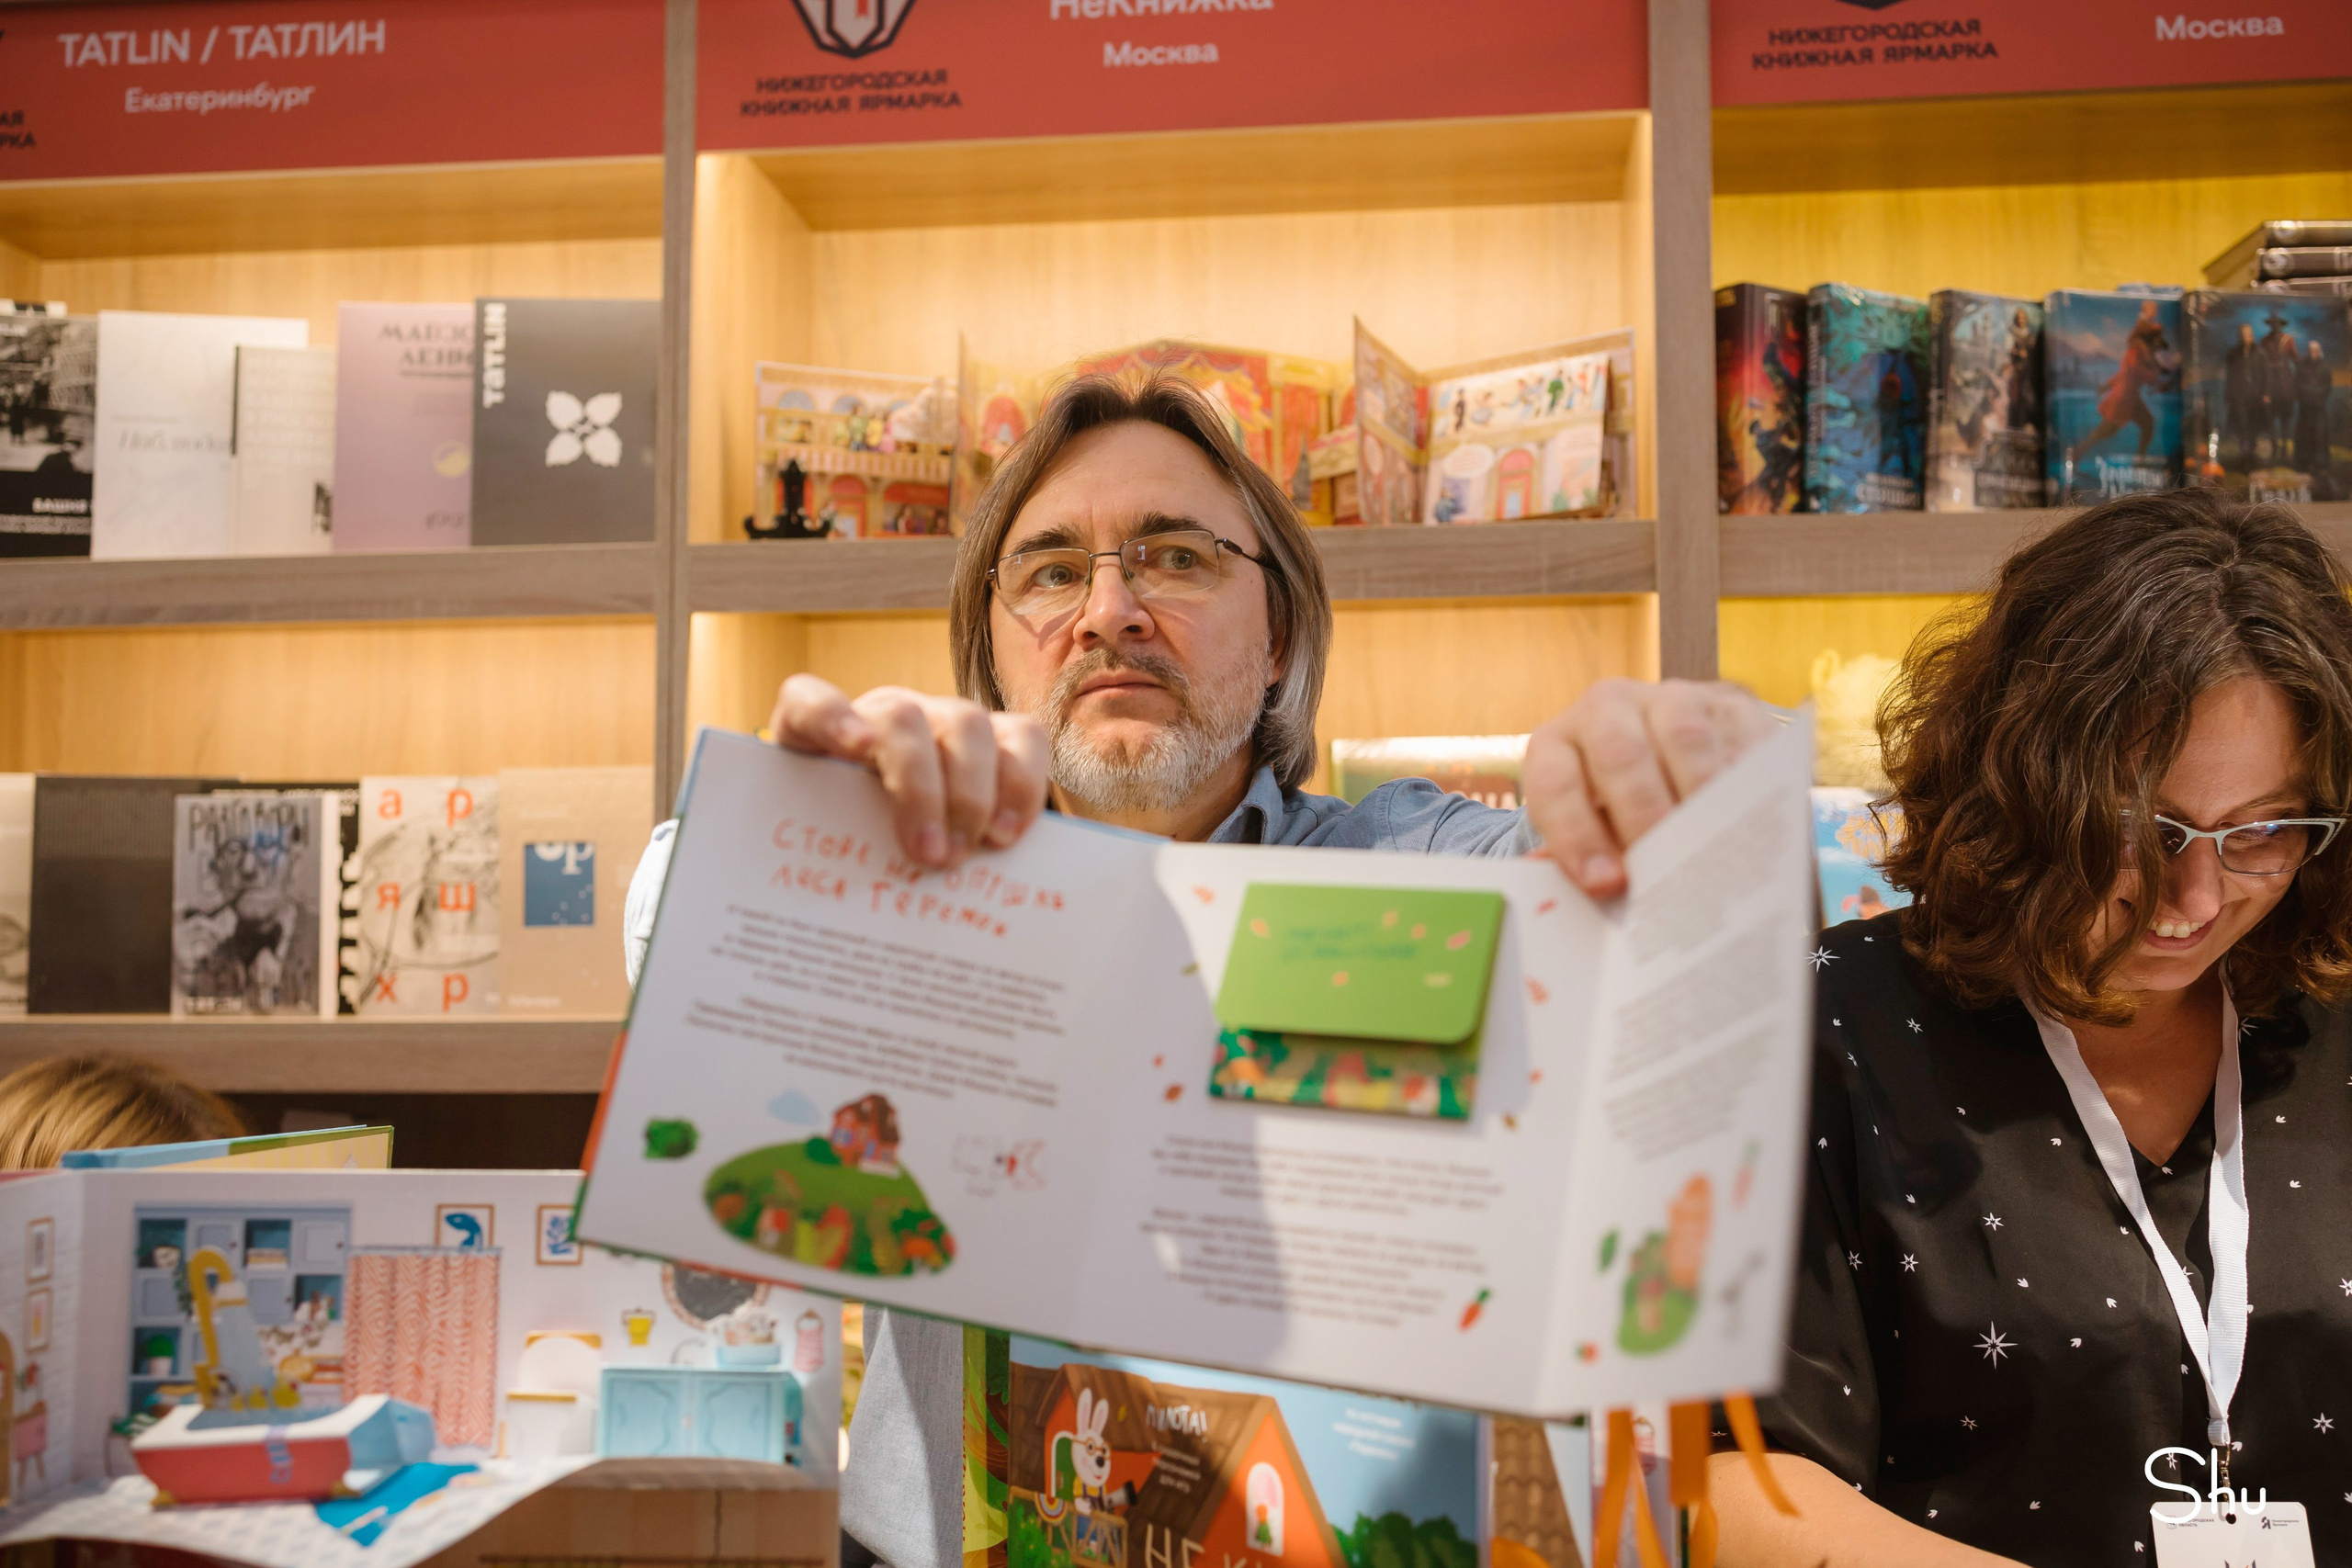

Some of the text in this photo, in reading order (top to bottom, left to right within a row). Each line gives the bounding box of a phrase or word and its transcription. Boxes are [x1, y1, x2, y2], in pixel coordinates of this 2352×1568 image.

[1768, 18, 1981, 45] НИЖЕГОРОДСКАЯ
[2154, 14, 2284, 41] Москва
[56, 18, 387, 68] TATLIN / ТАТЛИН
[1103, 40, 1220, 67] Москва
[1752, 40, 1999, 71] КНИЖНАЯ ЯРМАРКА
[124, 80, 317, 117] Екатеринбург
[859, 90, 963, 112] ЯРМАРКА
